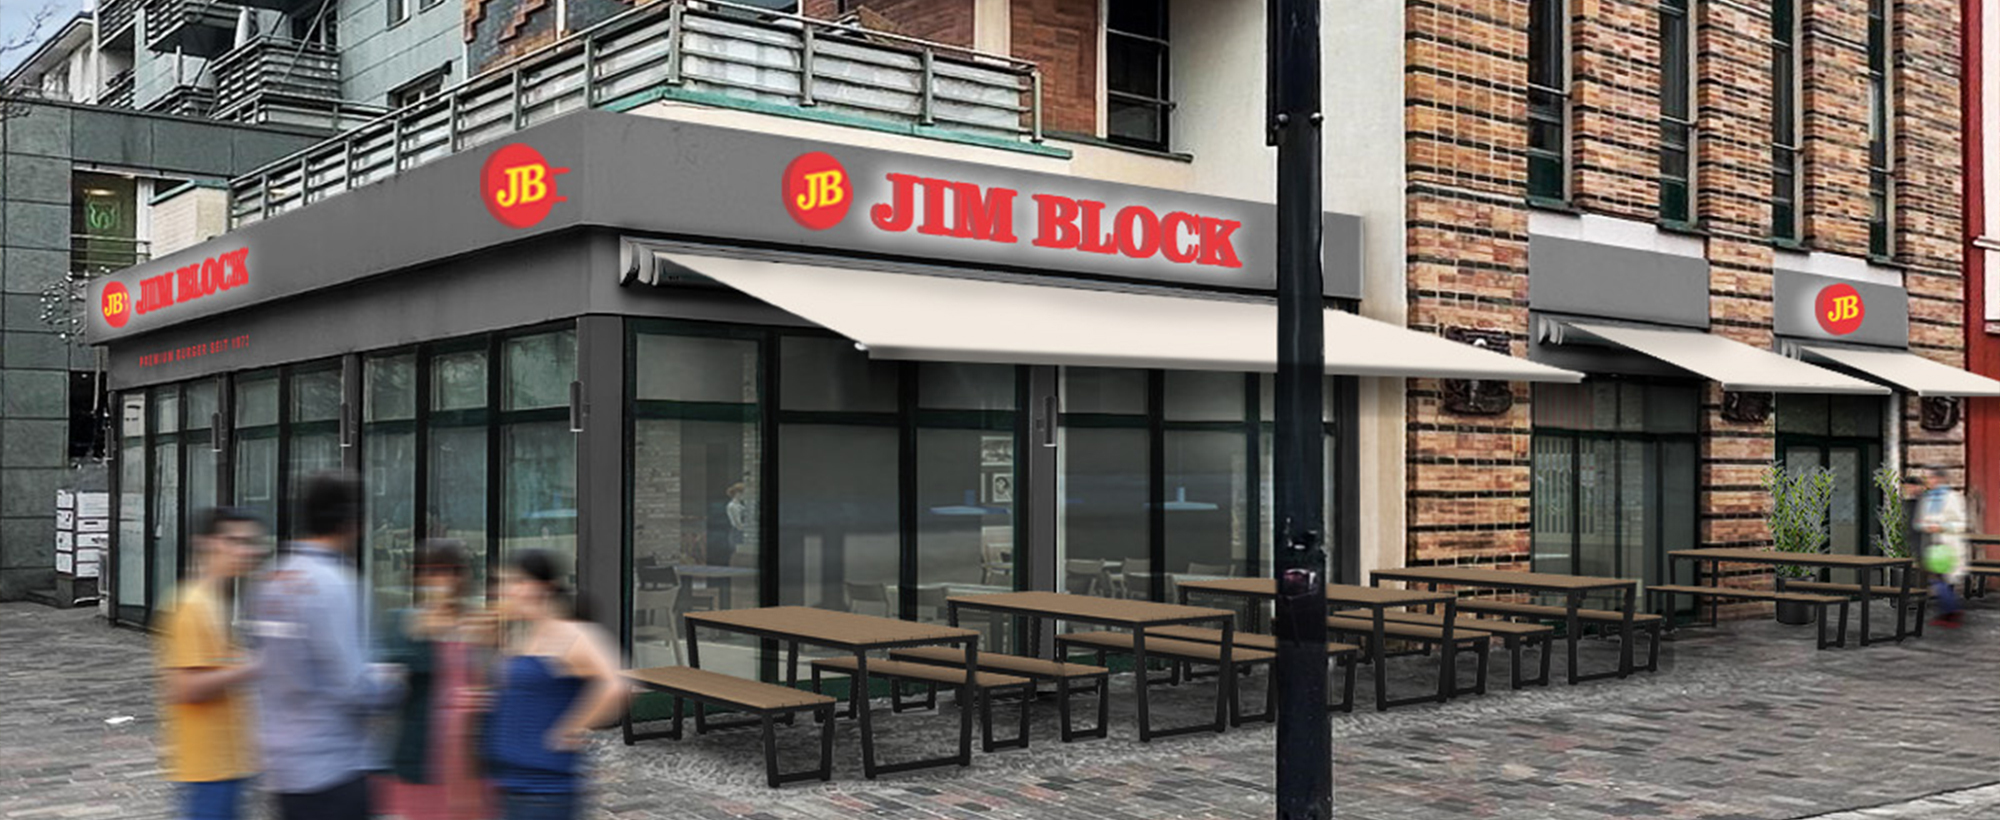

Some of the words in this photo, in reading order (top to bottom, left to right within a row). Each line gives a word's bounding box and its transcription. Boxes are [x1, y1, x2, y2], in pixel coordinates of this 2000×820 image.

[496, 163, 546, 207] JB
[797, 170, 844, 210] JB
[870, 173, 1018, 243] JIM
[1031, 194, 1243, 268] BLOCK
[135, 272, 174, 315] JIM
[176, 247, 249, 303] BLOCK
[104, 292, 124, 317] JB
[1827, 295, 1859, 322] JB
[176, 343, 207, 361] BURGER
[210, 338, 229, 354] SEIT
